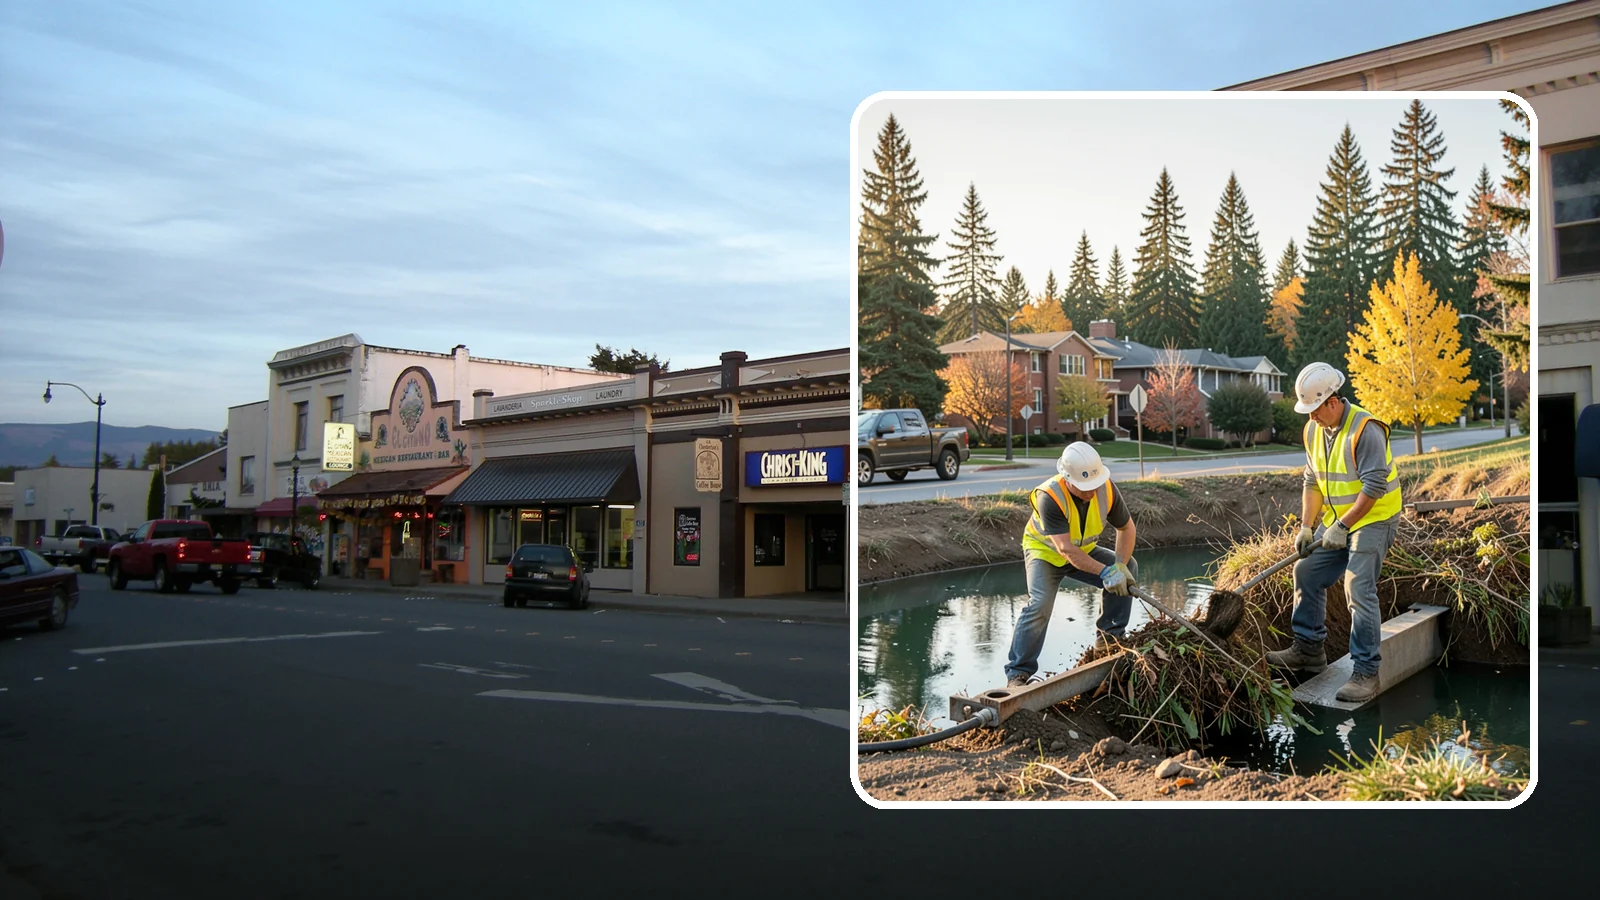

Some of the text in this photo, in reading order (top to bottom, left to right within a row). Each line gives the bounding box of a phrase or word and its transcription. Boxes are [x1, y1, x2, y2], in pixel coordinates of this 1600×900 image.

[494, 402, 522, 412] LAVANDERIA
[561, 395, 583, 405] Shop
[595, 389, 623, 400] LAUNDRY
[398, 451, 433, 462] RESTAURANT
[437, 450, 450, 459] BAR
[761, 450, 827, 478] CHRIST KING
